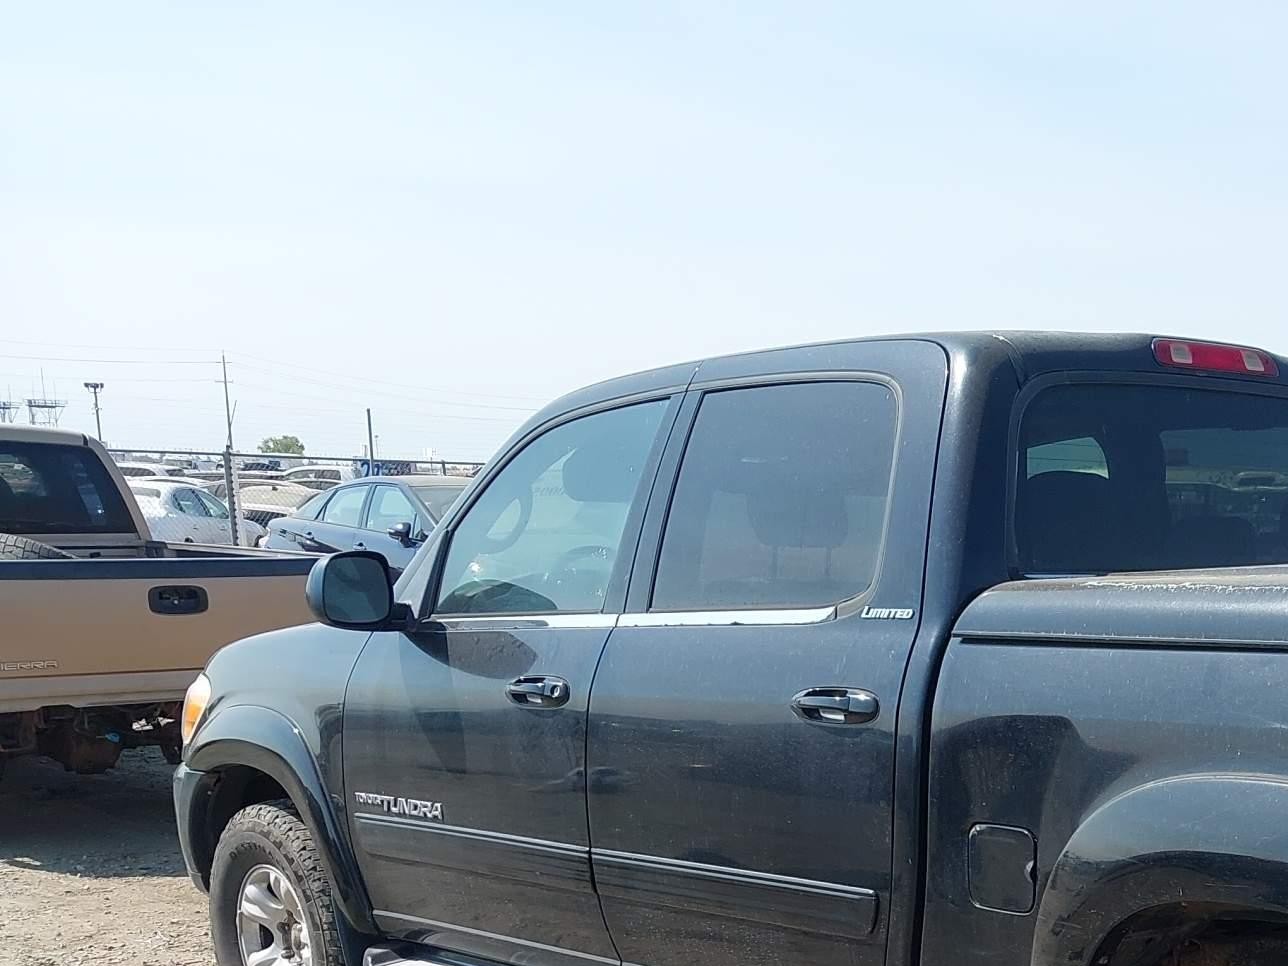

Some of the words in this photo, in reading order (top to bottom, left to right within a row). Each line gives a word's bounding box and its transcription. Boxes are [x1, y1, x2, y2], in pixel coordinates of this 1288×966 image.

[861, 605, 913, 619] LIMITED
[0, 660, 58, 671] IERRA
[380, 795, 443, 820] TUNDRA
